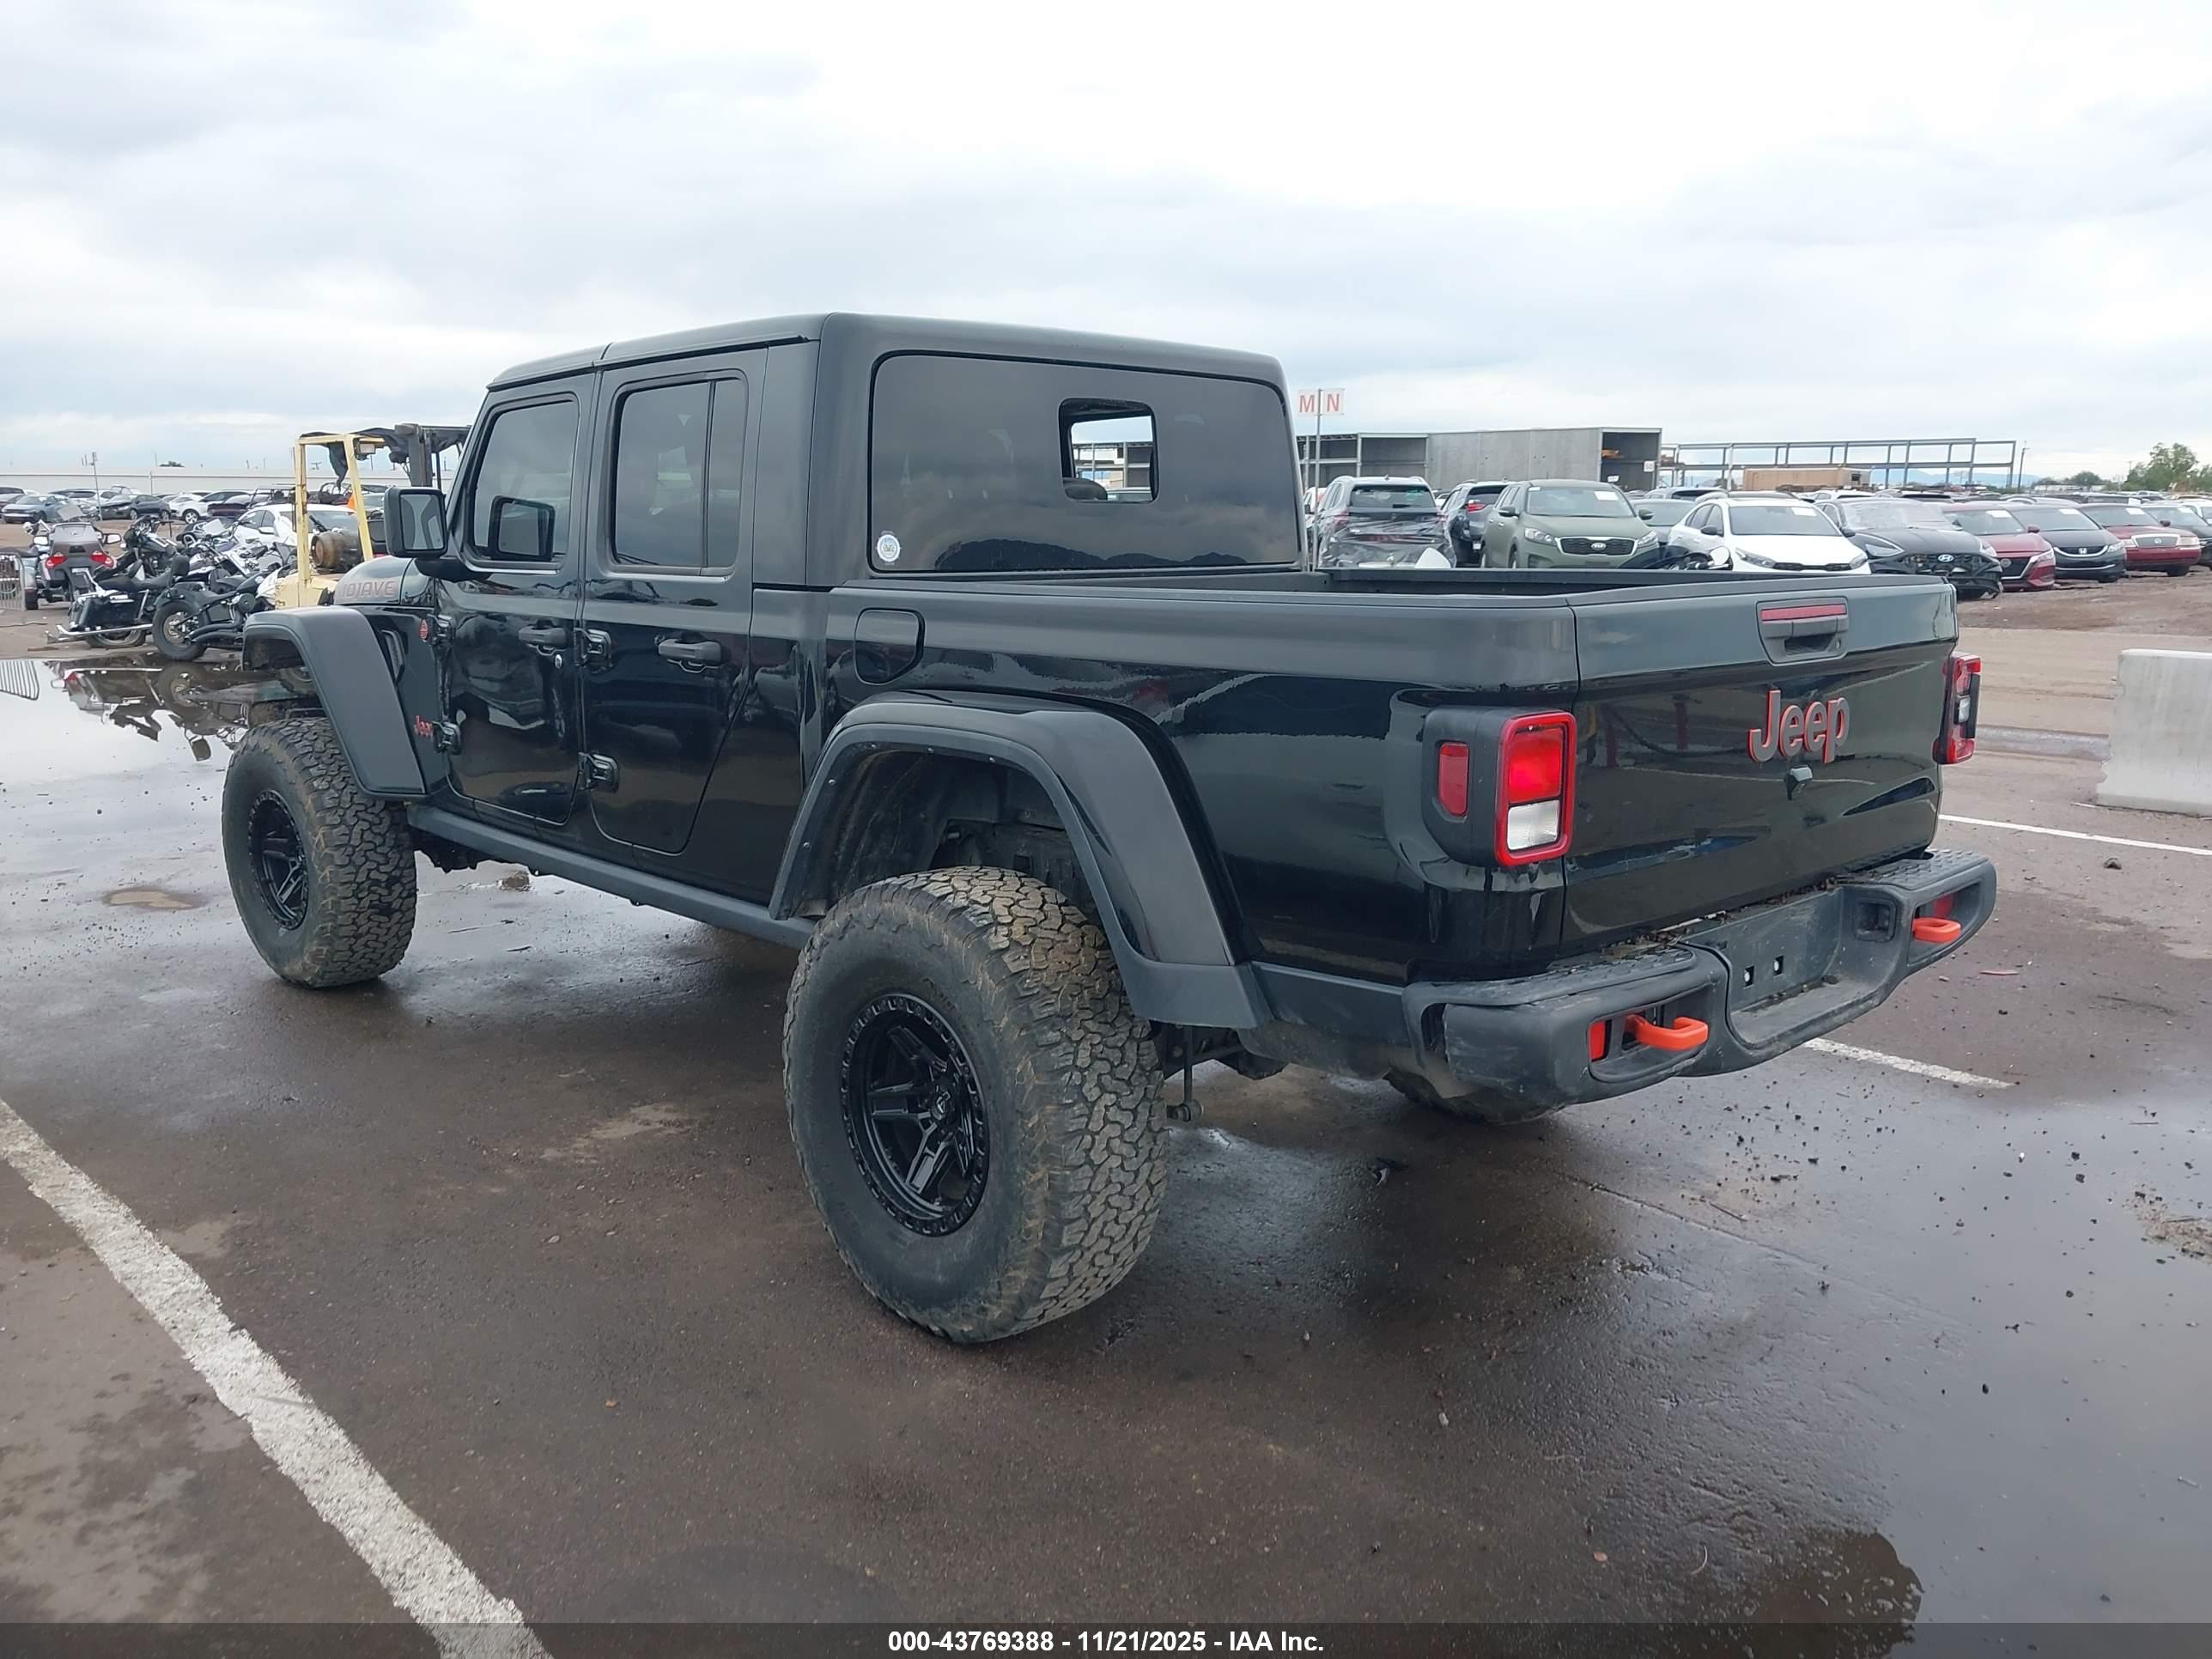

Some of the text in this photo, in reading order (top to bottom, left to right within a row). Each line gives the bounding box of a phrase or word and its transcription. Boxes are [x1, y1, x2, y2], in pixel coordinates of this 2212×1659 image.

[1299, 394, 1315, 412] M
[1327, 393, 1340, 412] N
[1748, 689, 1850, 764] Jeep
